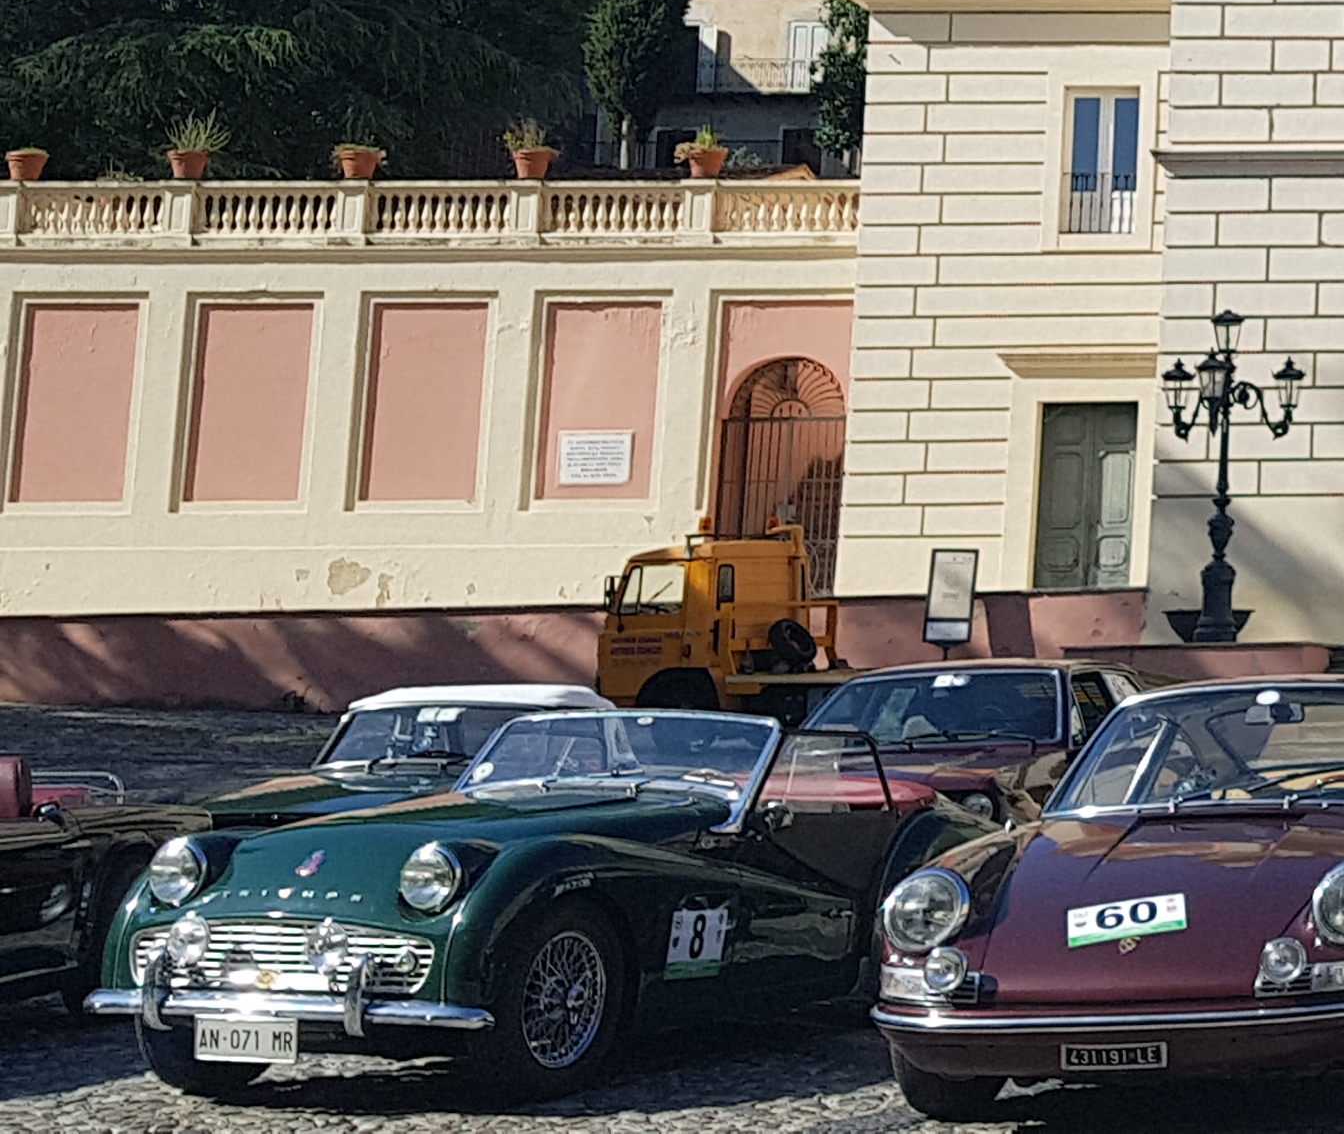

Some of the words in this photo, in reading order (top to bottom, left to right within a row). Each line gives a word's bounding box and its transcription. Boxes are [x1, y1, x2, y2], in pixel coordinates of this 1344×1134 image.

[1095, 901, 1158, 929] 60
[689, 913, 707, 959] 8
[272, 1031, 293, 1053] MR
